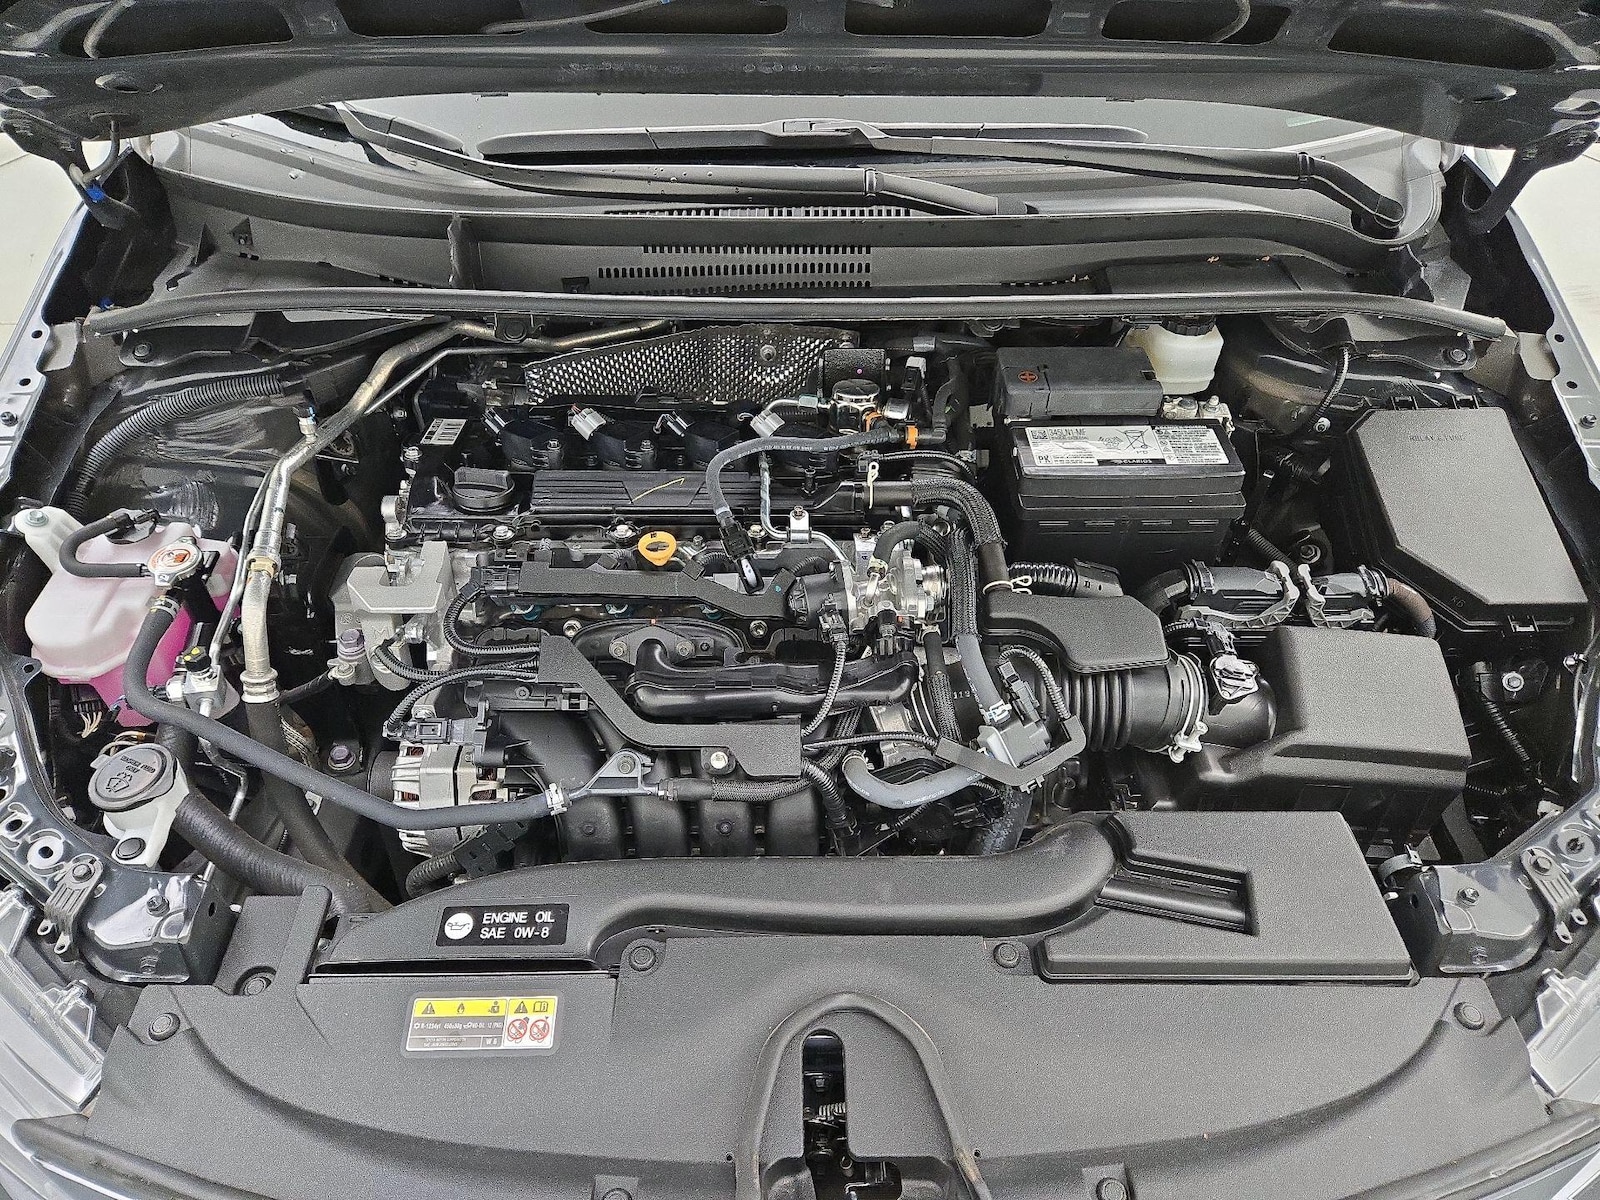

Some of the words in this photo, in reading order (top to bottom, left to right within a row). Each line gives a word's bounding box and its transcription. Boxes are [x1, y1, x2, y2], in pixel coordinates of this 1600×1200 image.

[482, 912, 529, 924] ENGINE
[535, 911, 555, 923] OIL
[480, 927, 506, 939] SAE
[514, 926, 550, 939] 0W-8
